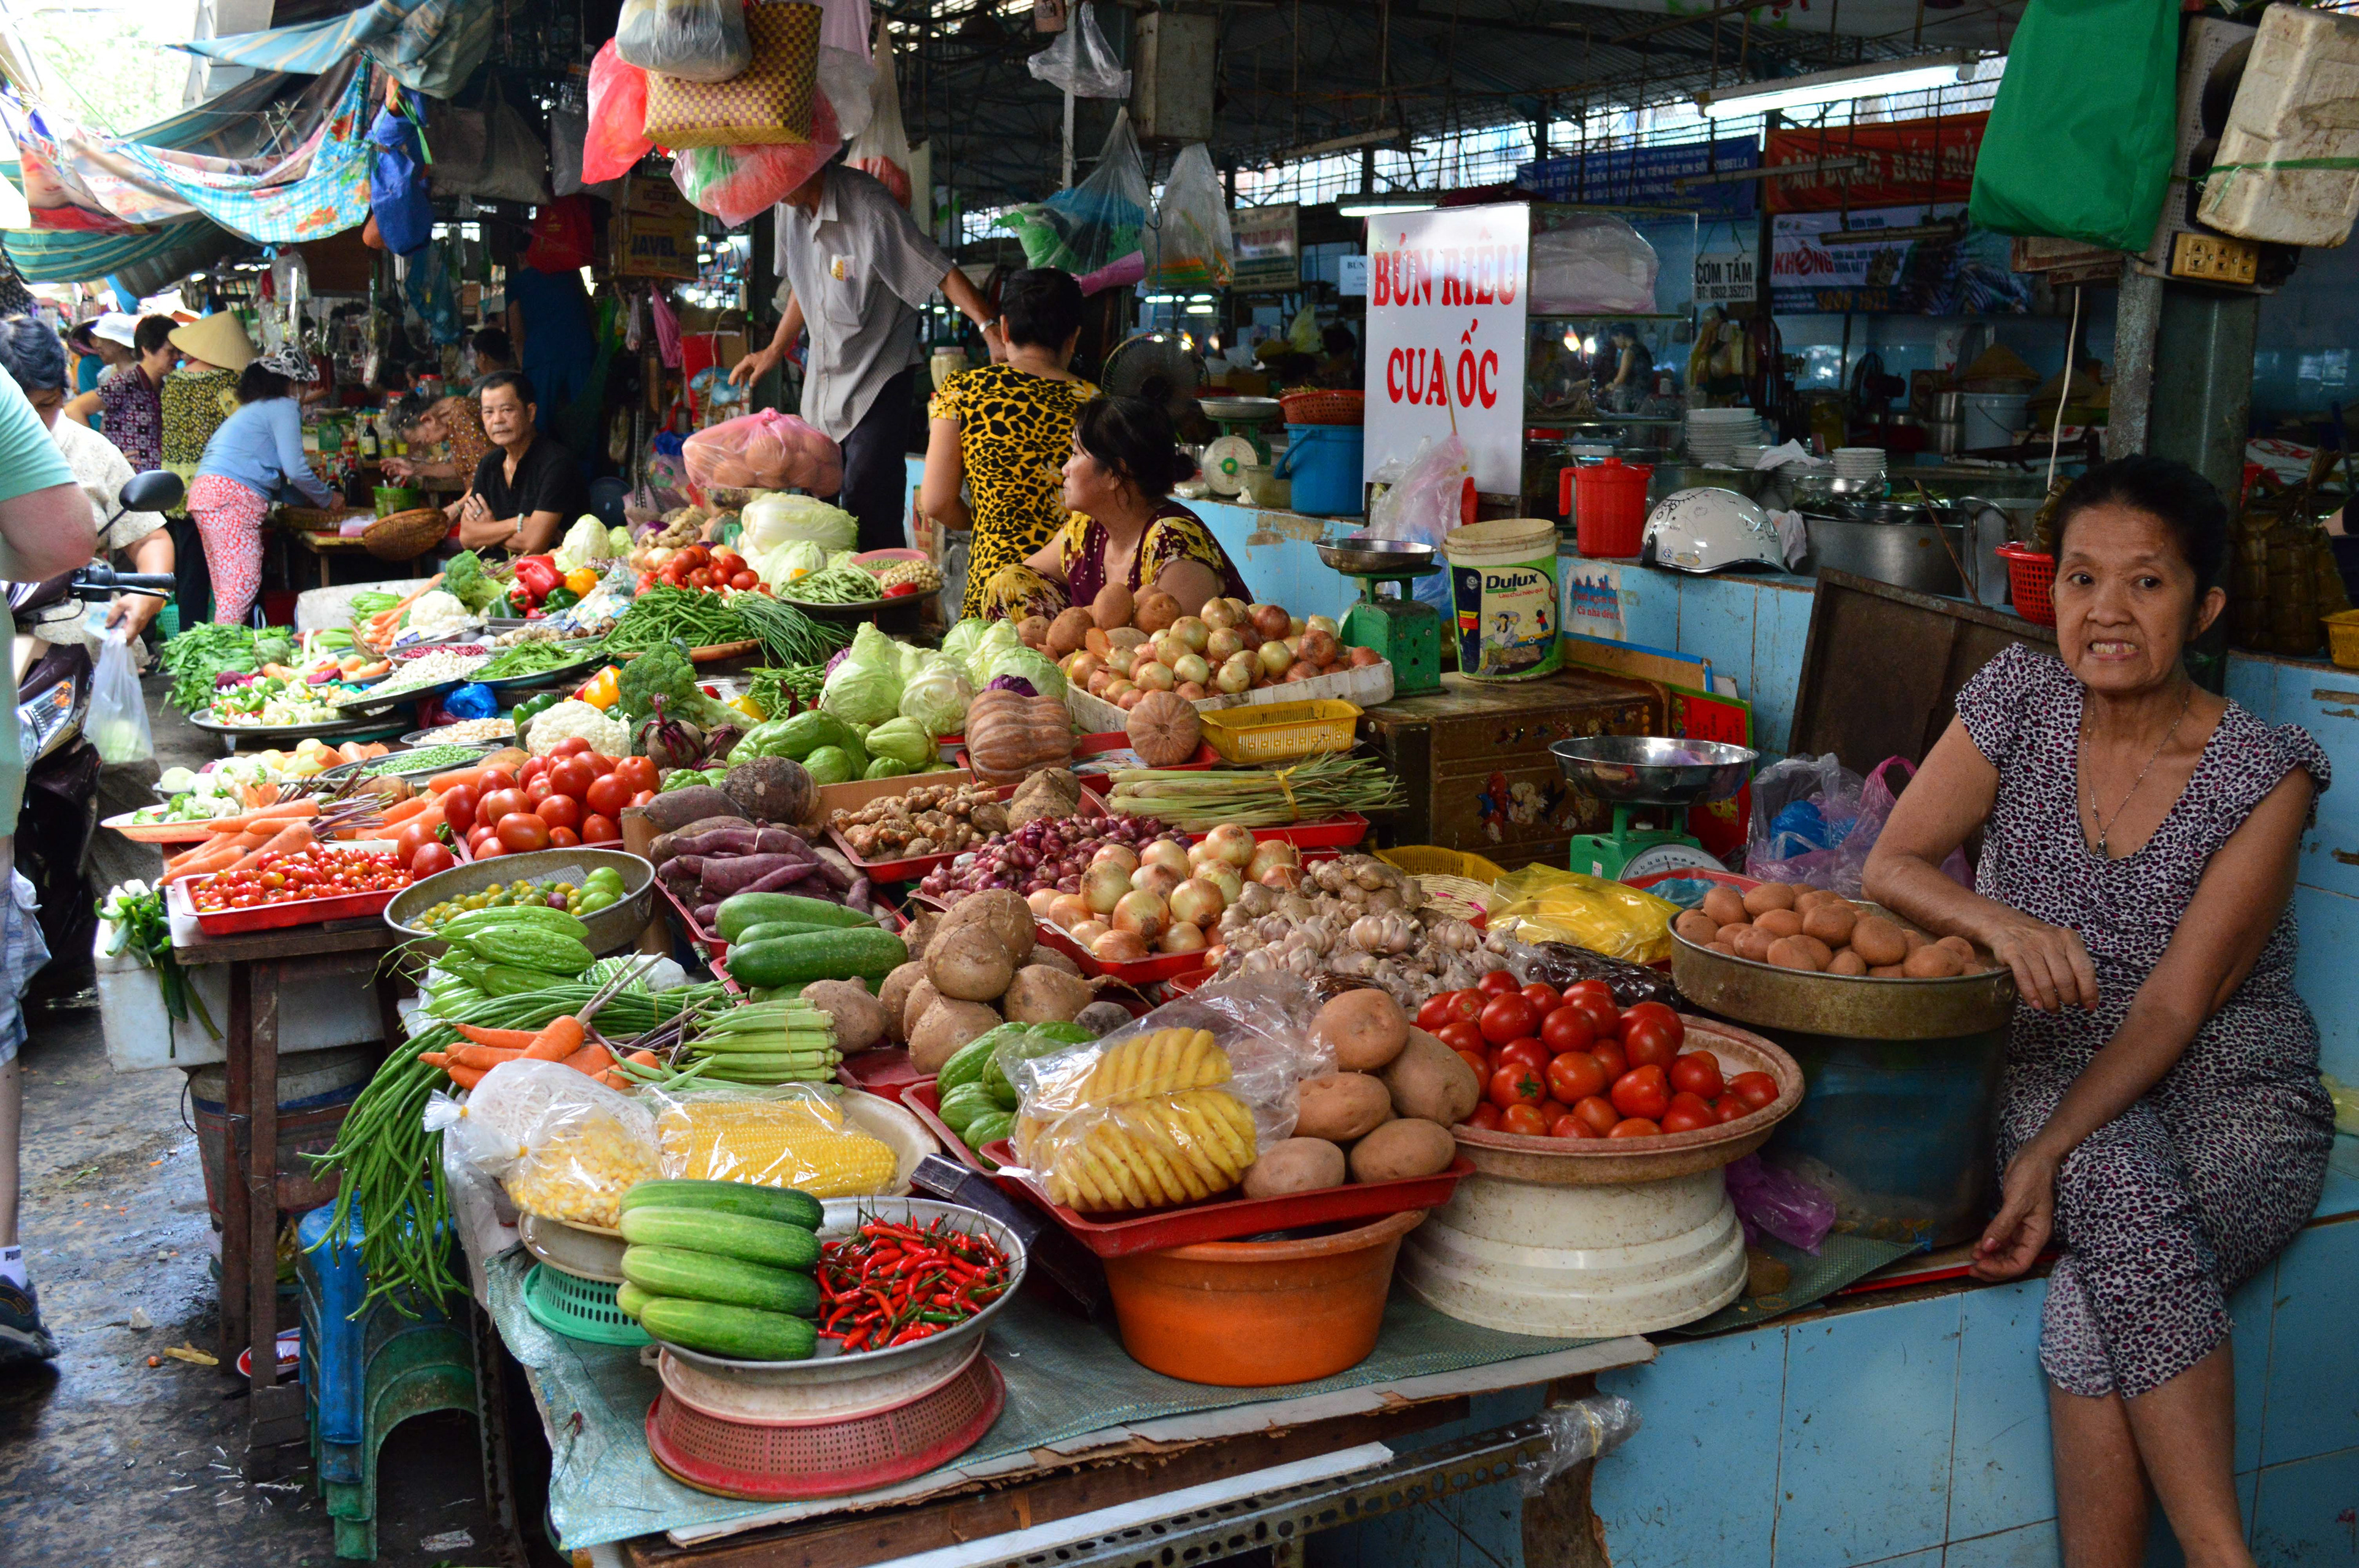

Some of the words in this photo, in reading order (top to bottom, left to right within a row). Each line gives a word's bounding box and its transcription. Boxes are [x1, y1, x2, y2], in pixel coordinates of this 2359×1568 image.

[1373, 232, 1434, 306] BÚN
[1442, 225, 1520, 306] RIÊU
[1696, 260, 1721, 284] CƠM
[1726, 253, 1752, 283] TẤM
[1387, 347, 1447, 407] CUA
[1456, 318, 1498, 409] ỐC
[1486, 573, 1537, 589] Dulux
